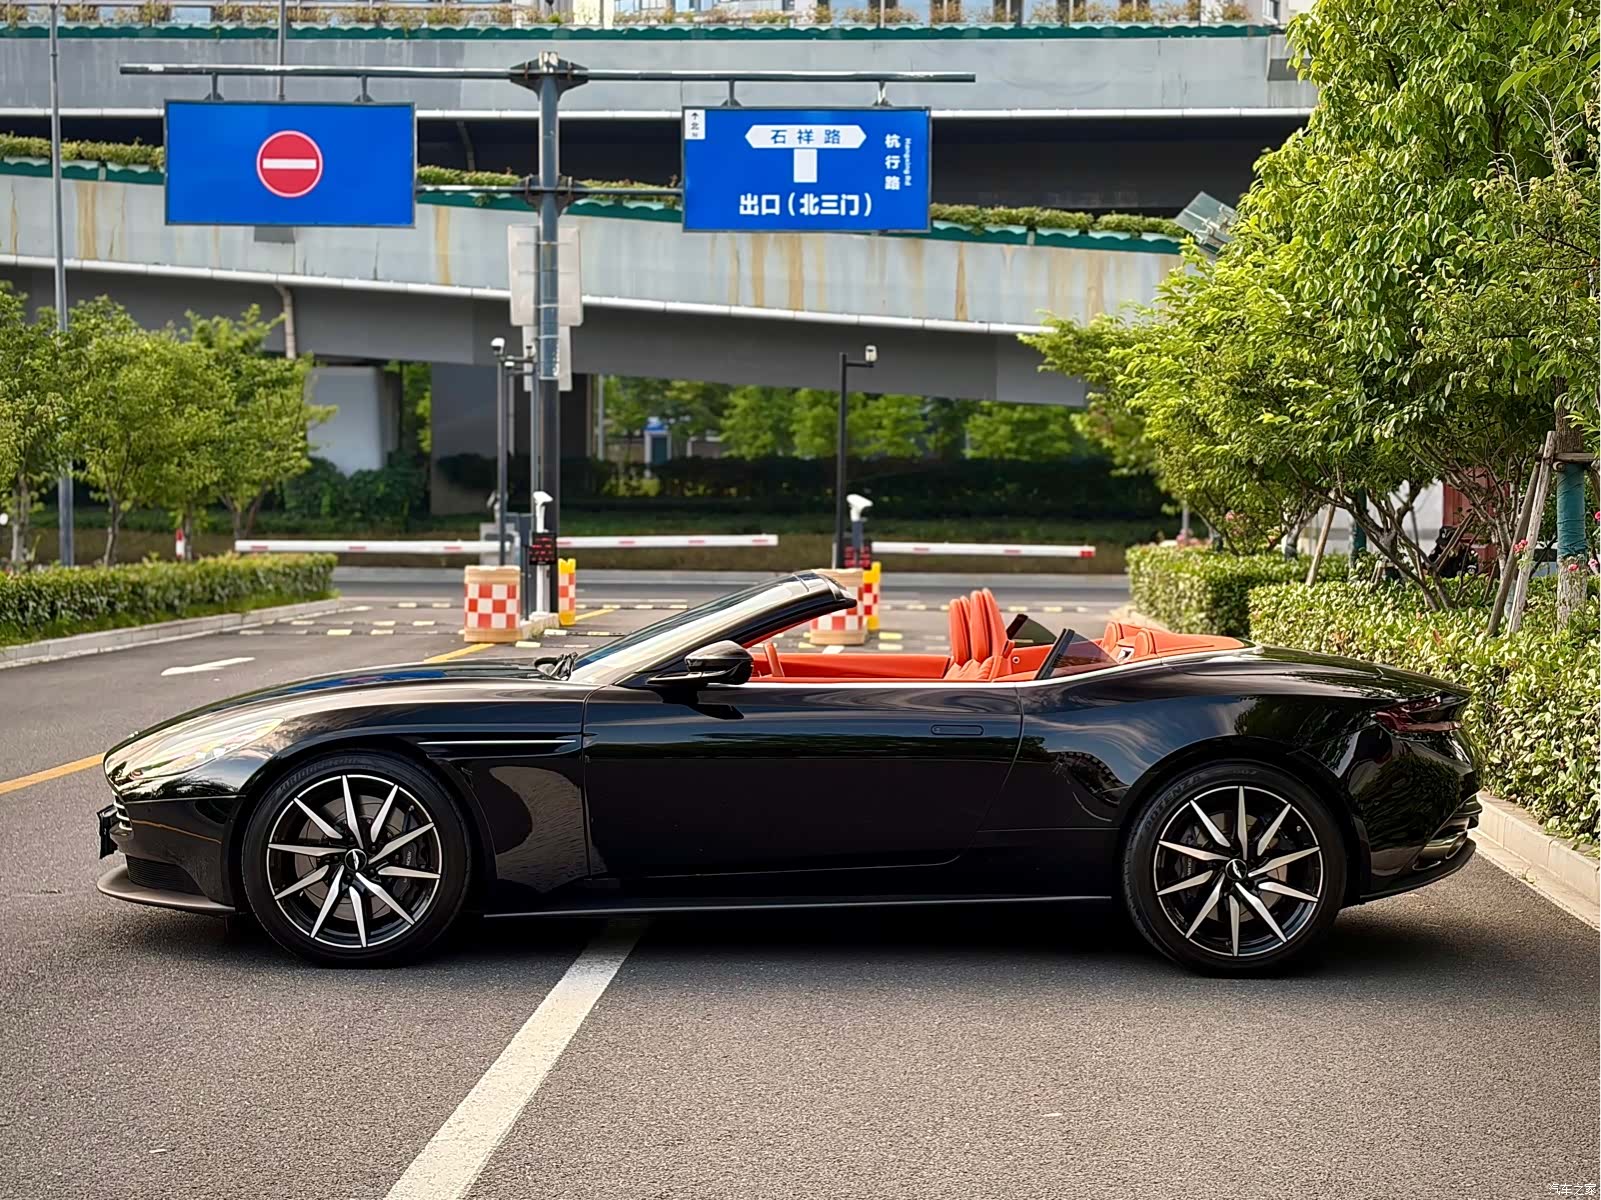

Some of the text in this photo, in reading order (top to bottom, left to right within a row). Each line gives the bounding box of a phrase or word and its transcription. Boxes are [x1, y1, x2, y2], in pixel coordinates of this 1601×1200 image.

[691, 122, 700, 131] 北
[770, 129, 841, 145] 石祥路
[884, 133, 901, 191] 杭行路
[904, 175, 912, 187] Rd
